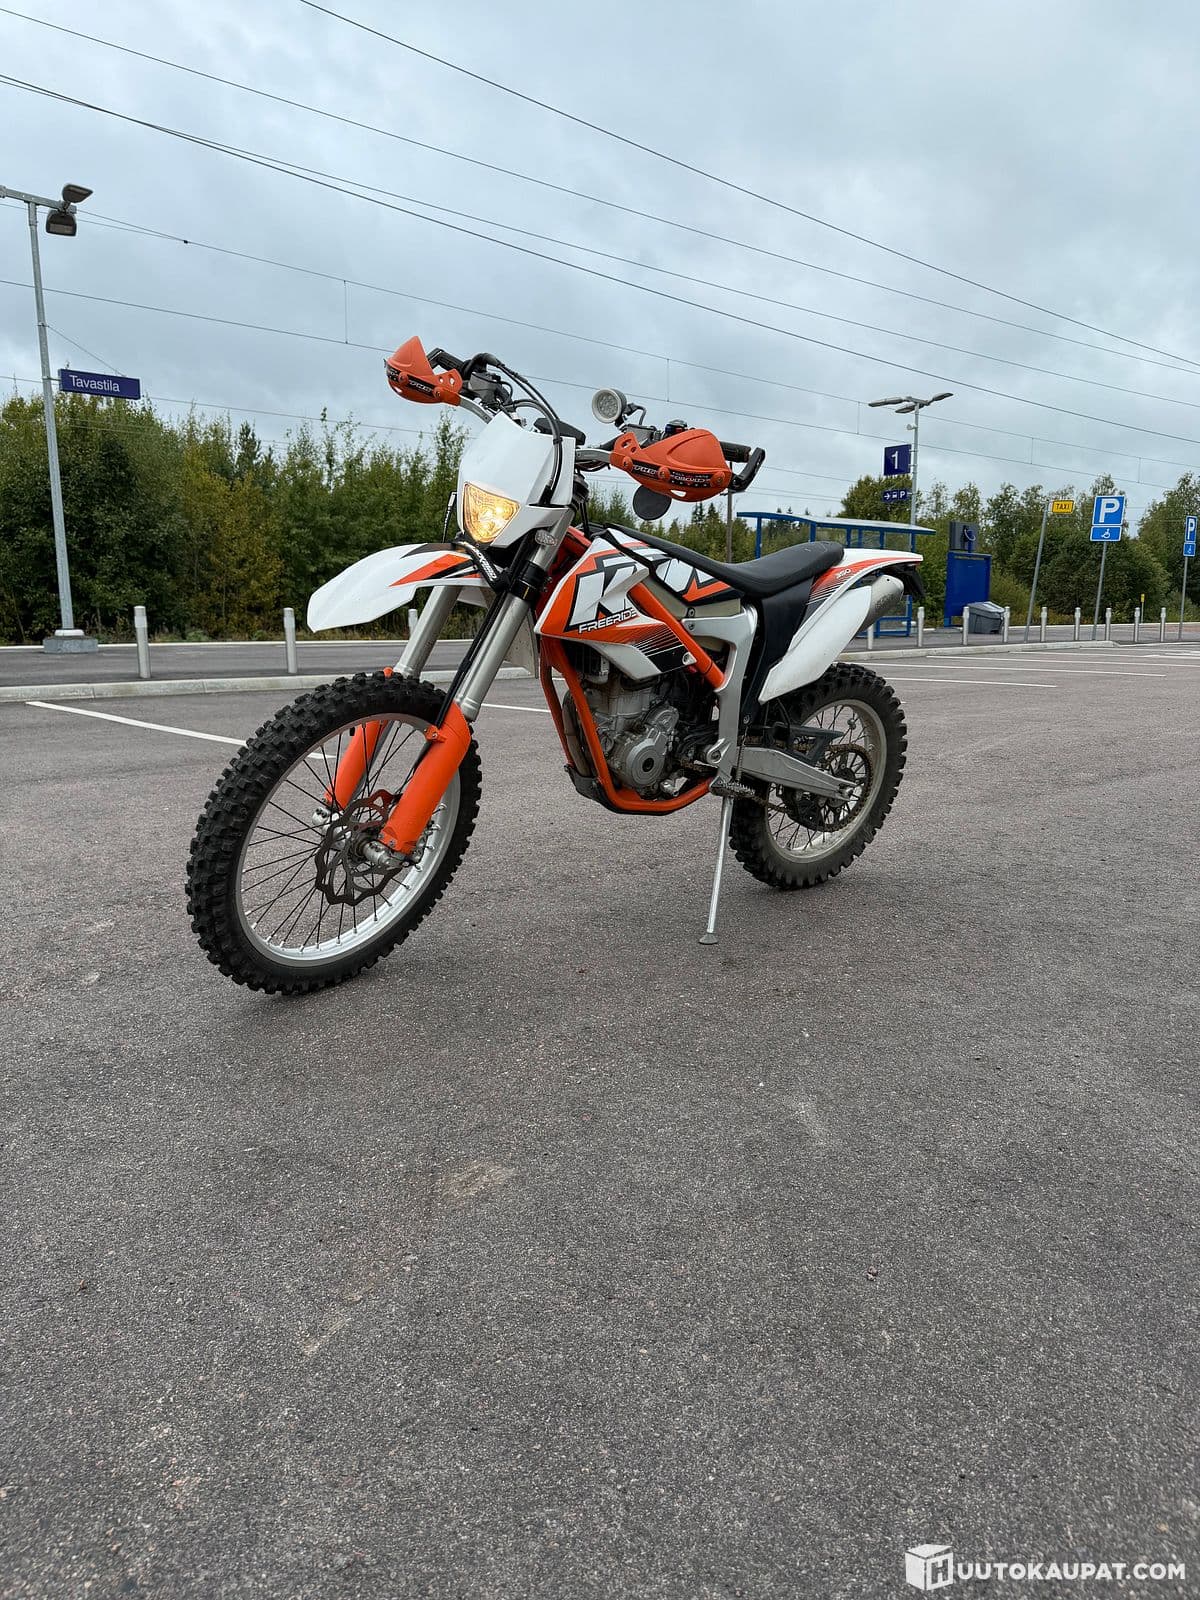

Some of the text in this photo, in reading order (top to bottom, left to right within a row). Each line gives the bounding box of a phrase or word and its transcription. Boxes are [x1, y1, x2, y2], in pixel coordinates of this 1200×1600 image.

[69, 374, 120, 393] Tavastila
[891, 450, 899, 470] 1
[900, 491, 906, 499] P
[1098, 498, 1120, 523] P
[1187, 518, 1196, 540] P
[578, 608, 638, 634] FREERIDE
